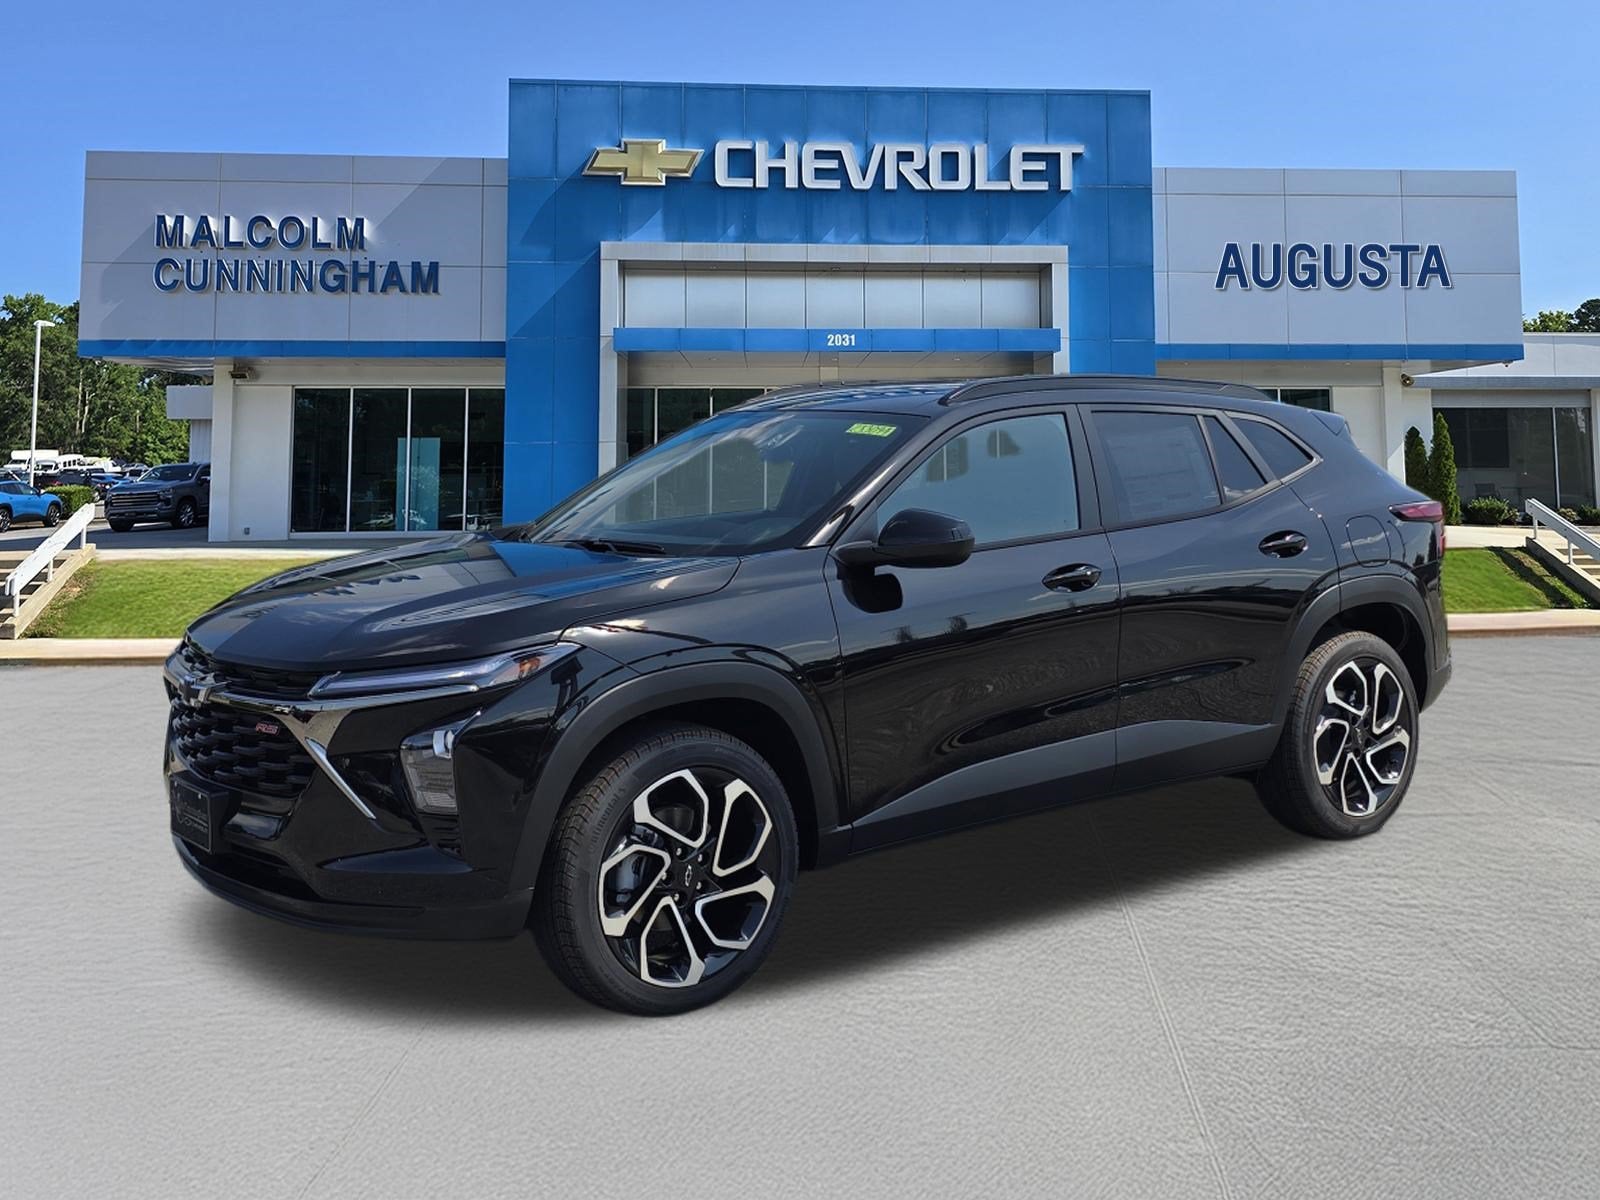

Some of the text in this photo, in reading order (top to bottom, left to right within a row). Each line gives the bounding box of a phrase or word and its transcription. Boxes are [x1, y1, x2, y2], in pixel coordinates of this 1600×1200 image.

[714, 139, 1085, 192] CHEVROLET
[154, 214, 367, 250] MALCOLM
[153, 257, 441, 294] CUNNINGHAM
[1214, 242, 1452, 289] AUGUSTA
[827, 333, 856, 347] 2031
[588, 792, 620, 855] ntinental
